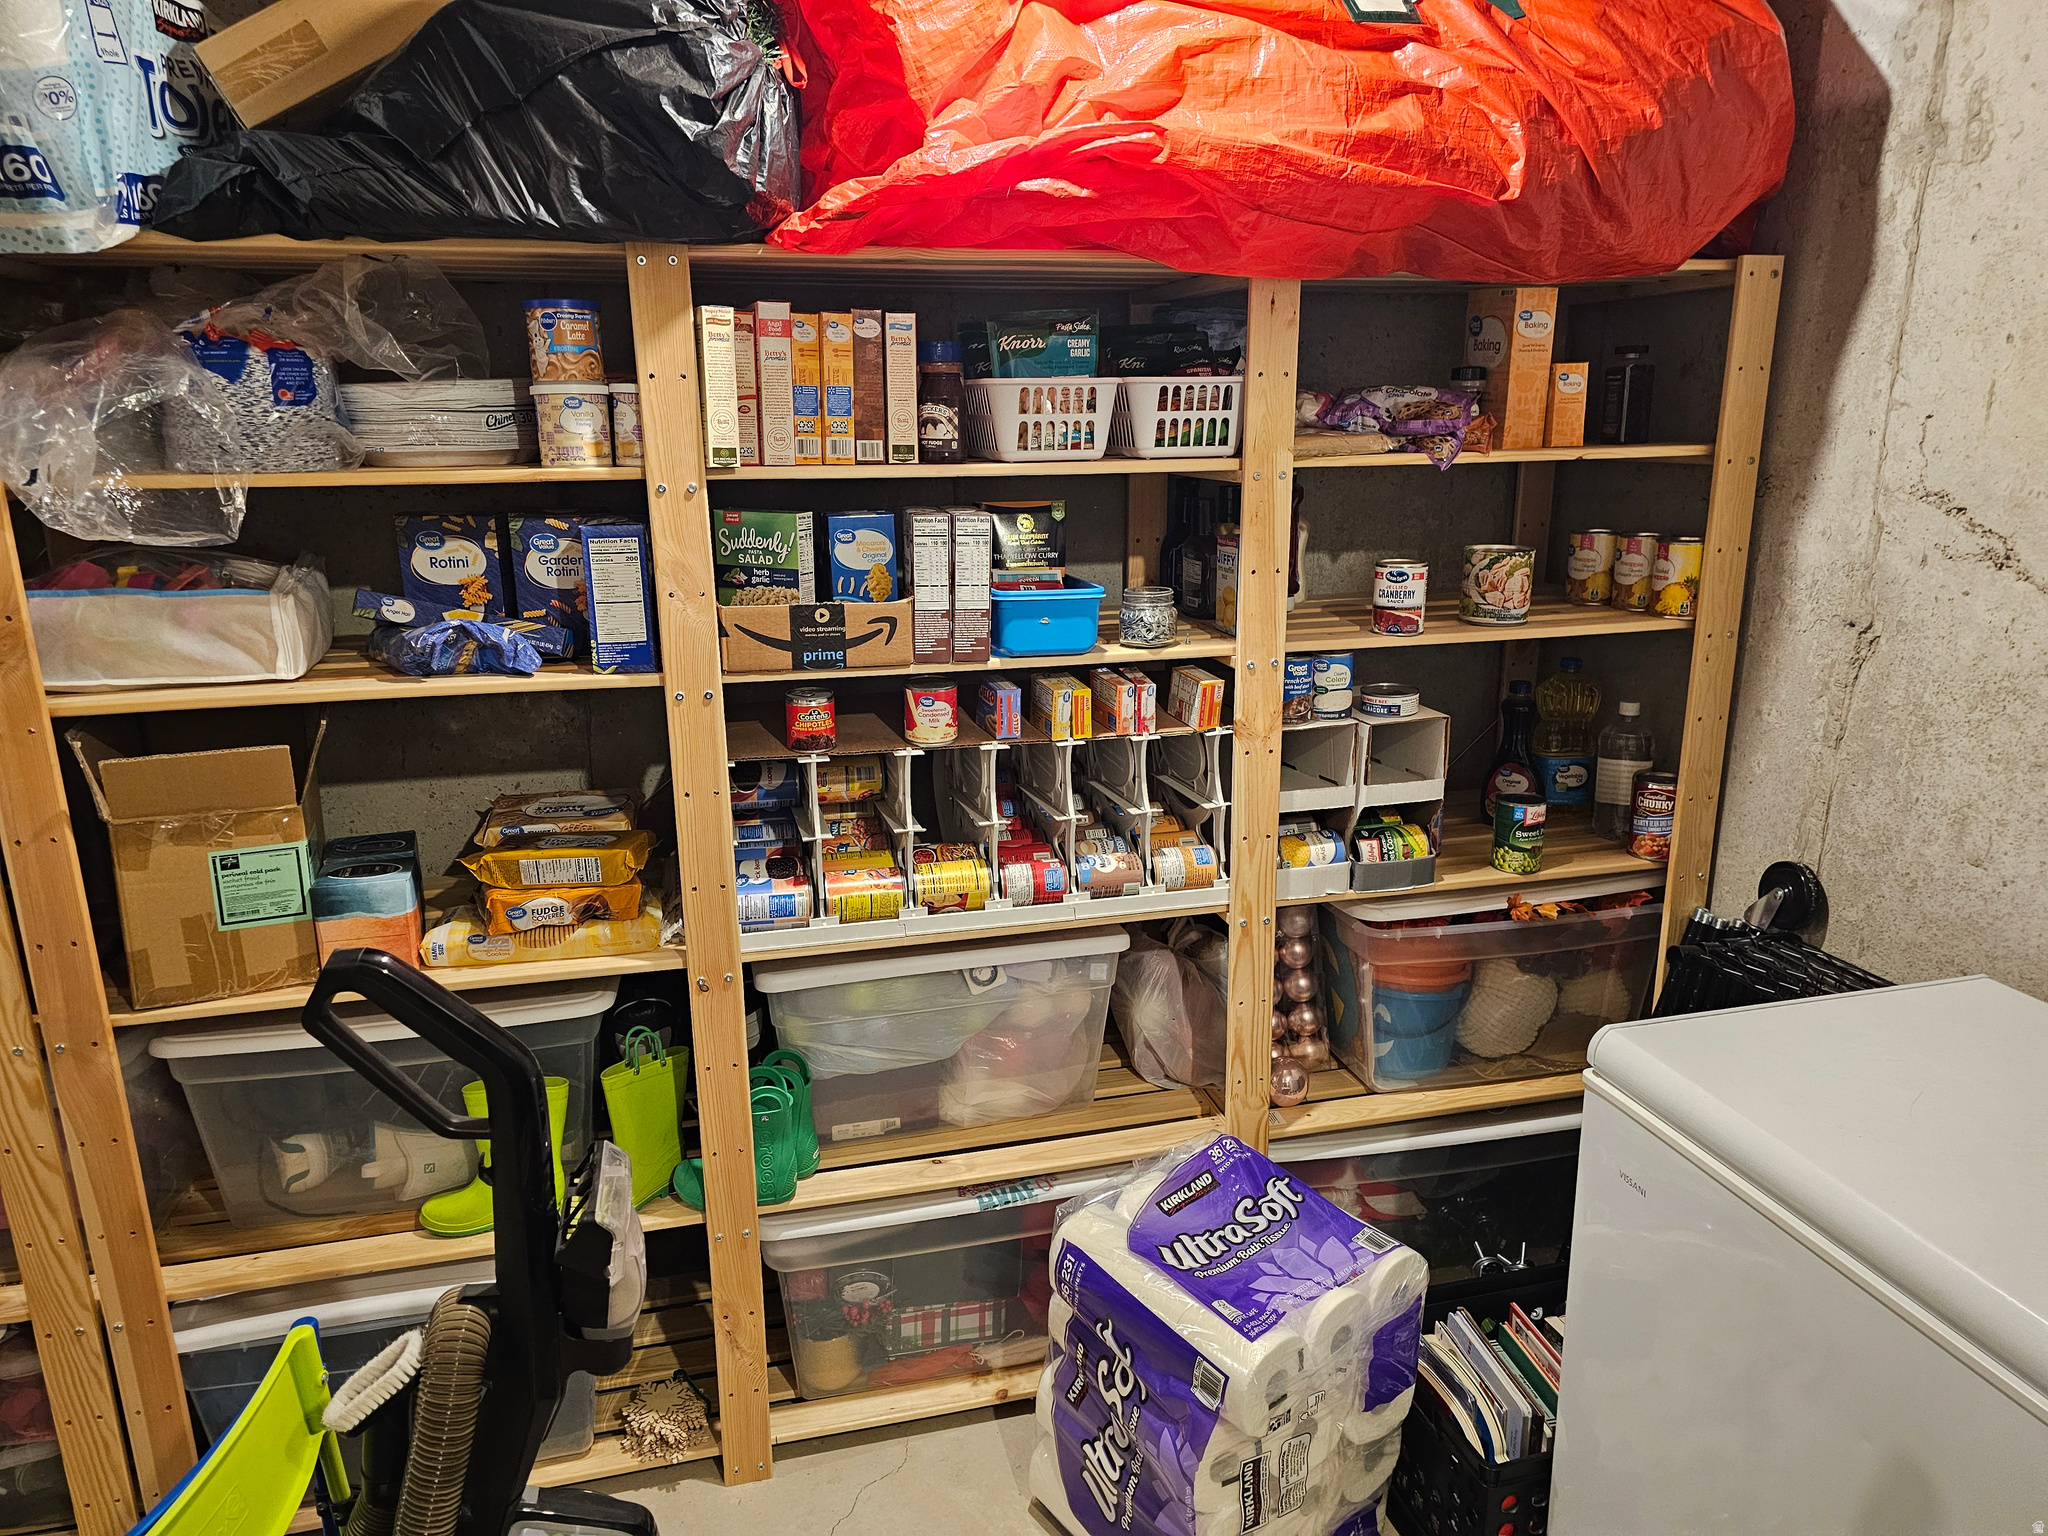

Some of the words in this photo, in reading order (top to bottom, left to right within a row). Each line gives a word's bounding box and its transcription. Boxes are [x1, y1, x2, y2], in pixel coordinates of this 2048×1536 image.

[0, 153, 52, 184] 60
[560, 321, 590, 331] Caramel
[1525, 322, 1548, 330] Baking
[567, 331, 586, 341] Latte
[998, 335, 1046, 351] Knorr
[1067, 339, 1090, 348] CREAMY
[1473, 339, 1501, 354] Baking
[1070, 349, 1090, 357] GARLIC
[419, 535, 440, 543] Great
[533, 538, 554, 546] Great
[719, 527, 795, 564] Suddenly!
[429, 556, 469, 569] Rotini
[538, 555, 583, 567] Garden
[738, 554, 773, 565] SALAD
[546, 566, 579, 577] Rotini
[753, 568, 770, 576] herb
[751, 576, 770, 584] garlic
[1378, 588, 1416, 600] CRANBERRY
[386, 607, 401, 616] Angel
[803, 648, 844, 664] prime
[1362, 705, 1388, 714] ALBACORE
[795, 719, 833, 728] CHIPOTLES
[1558, 773, 1584, 781] Vegetable
[1638, 795, 1674, 810] CHUNKY
[1515, 830, 1537, 838] Sweet
[1383, 831, 1393, 850] Corn
[531, 905, 565, 916] FUDGE
[531, 911, 565, 922] COVERED
[1208, 1145, 1223, 1160] 36
[1217, 1157, 1234, 1173] WIDE
[1619, 1169, 1647, 1198] VISSANI
[1160, 1173, 1213, 1211] KIRKLAND
[1194, 1256, 1241, 1279] Premium
[1236, 1241, 1262, 1260] Bath
[1260, 1222, 1292, 1245] Tissue
[1061, 1253, 1075, 1282] 231
[1244, 1462, 1254, 1528] KIRKLAND
[1121, 1476, 1139, 1532] Premium
